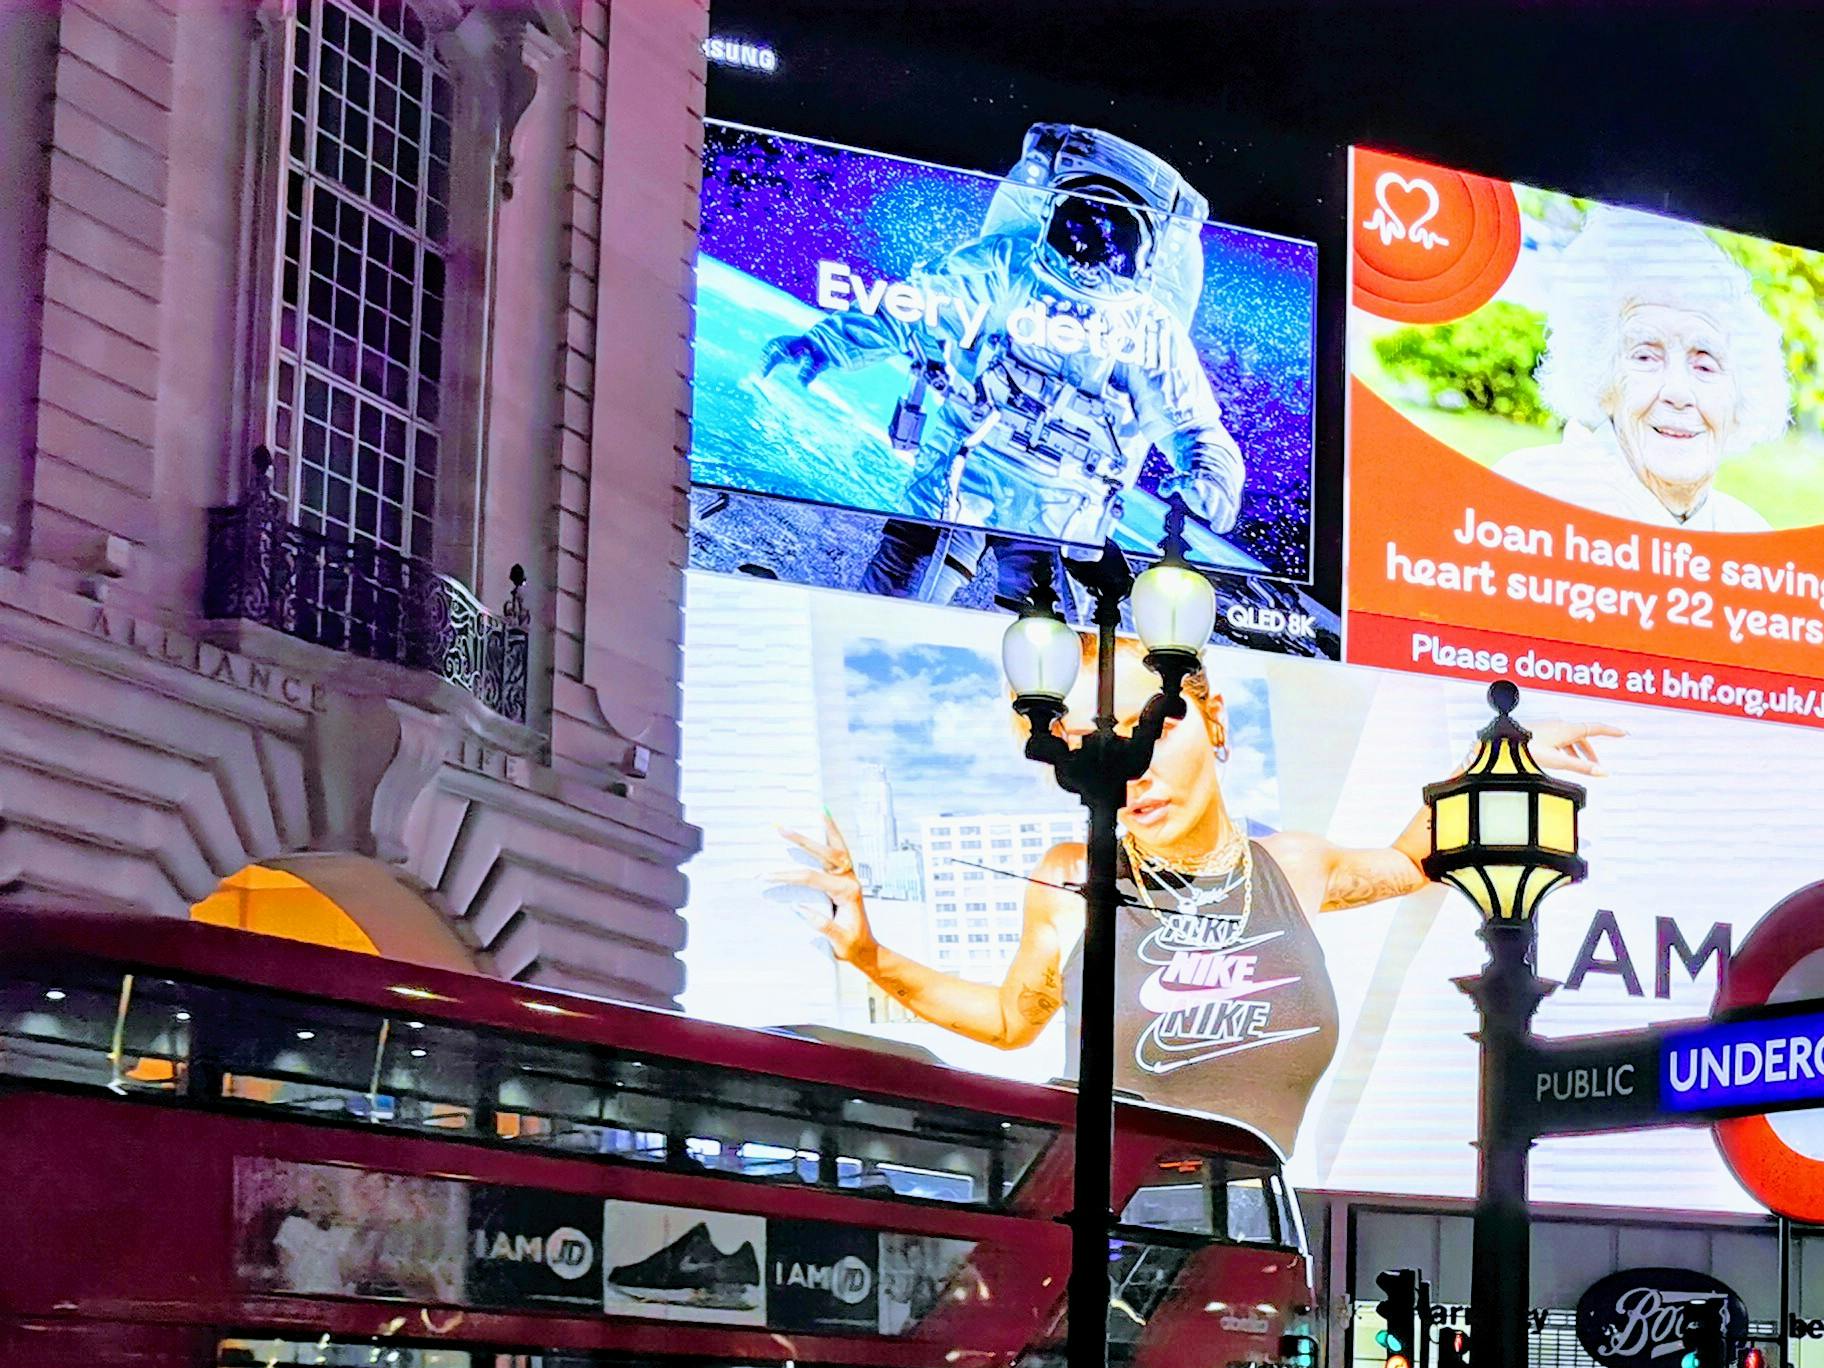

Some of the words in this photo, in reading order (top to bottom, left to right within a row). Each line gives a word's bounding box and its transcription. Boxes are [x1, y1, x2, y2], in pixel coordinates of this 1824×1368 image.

[817, 259, 992, 350] Every
[1005, 298, 1173, 371] detail
[1454, 507, 1553, 557] Joan
[1566, 524, 1640, 571] had
[1651, 538, 1711, 581] life
[1386, 541, 1496, 596] heart
[1507, 573, 1657, 631] surgery
[1666, 587, 1713, 628] 22
[1724, 602, 1823, 644] years
[1227, 604, 1286, 632] QLED
[1288, 613, 1317, 638] 8K
[92, 605, 328, 713] ALLIANCE
[1412, 633, 1509, 674] Please
[1515, 649, 1619, 689] donate
[1626, 668, 1656, 696] at
[1162, 952, 1258, 988] NIKE
[1563, 909, 1732, 999] AM
[1160, 1000, 1270, 1041] NIKE
[1537, 1064, 1634, 1101] PUBLIC
[490, 1232, 541, 1263] AM
[787, 1264, 831, 1289] AM
